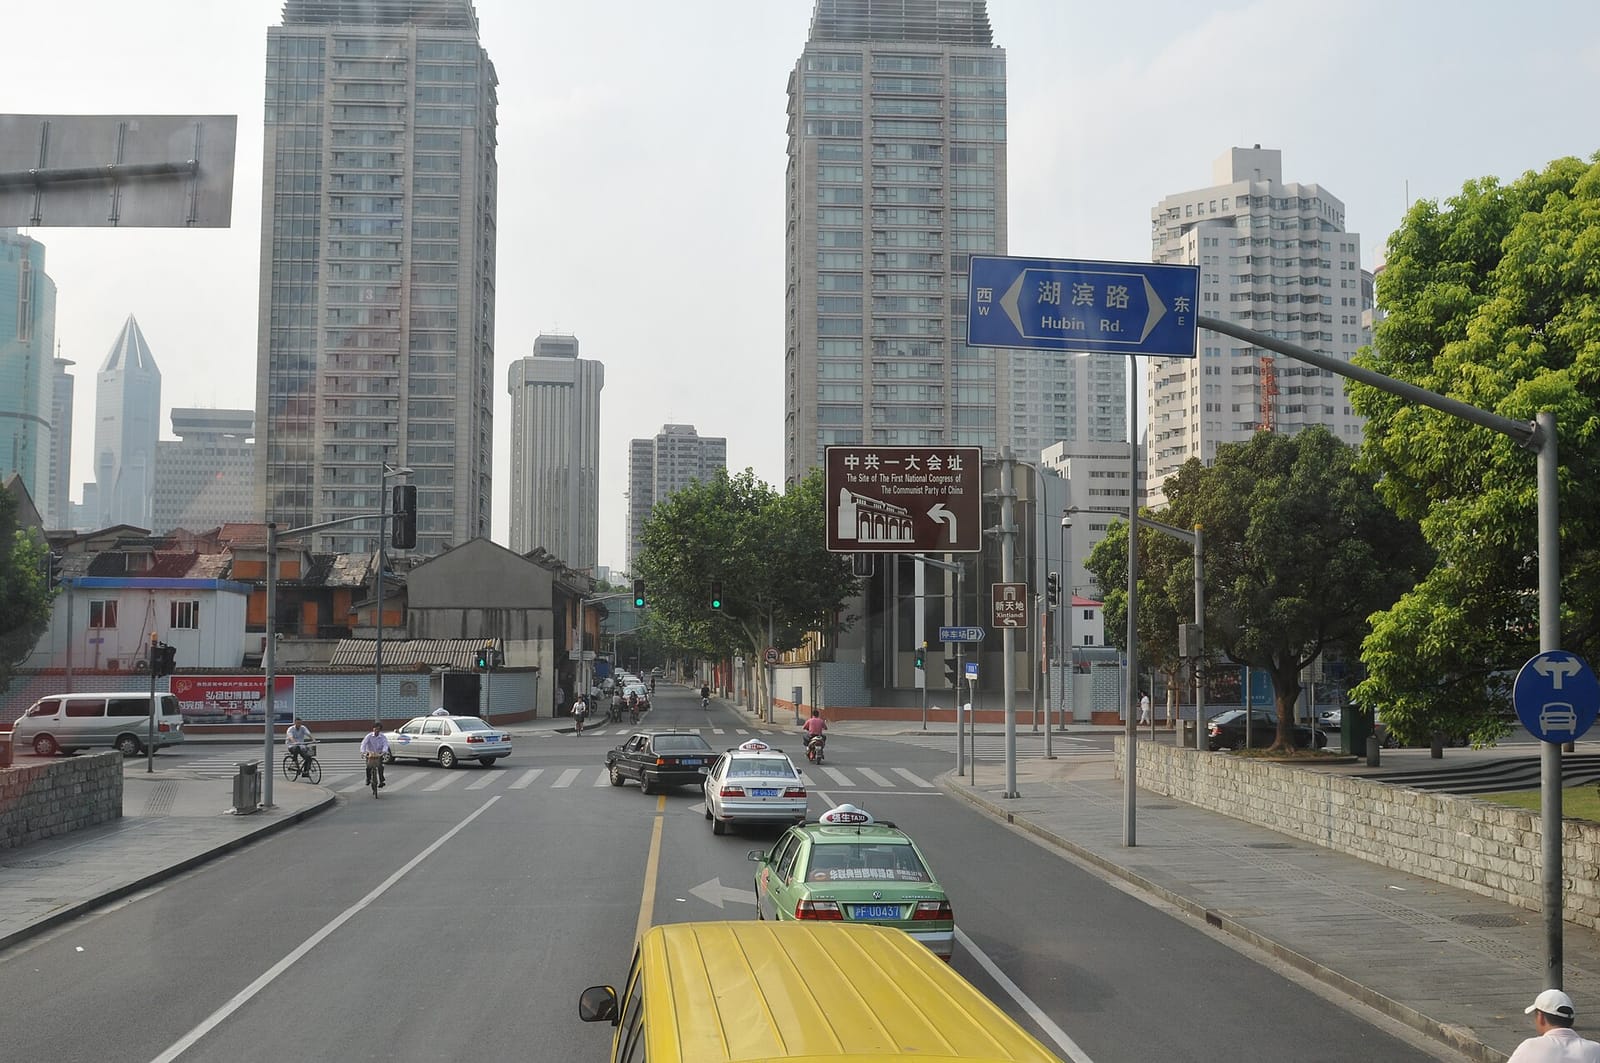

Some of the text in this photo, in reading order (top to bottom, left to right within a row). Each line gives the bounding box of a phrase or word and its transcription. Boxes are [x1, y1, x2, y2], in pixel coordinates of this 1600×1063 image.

[976, 287, 993, 304] 西
[1037, 280, 1130, 309] 湖滨路
[1174, 296, 1190, 313] 东
[978, 306, 990, 316] W
[1041, 316, 1125, 333] Hubin Rd.
[1178, 317, 1185, 326] E
[844, 453, 963, 471] 中共一大会址
[847, 473, 961, 484] The Site of The First National Congress of
[881, 485, 963, 496] The Communist Party of China
[995, 601, 1024, 611] 新天地
[941, 630, 967, 639] 停车场
[832, 813, 851, 823] 强生
